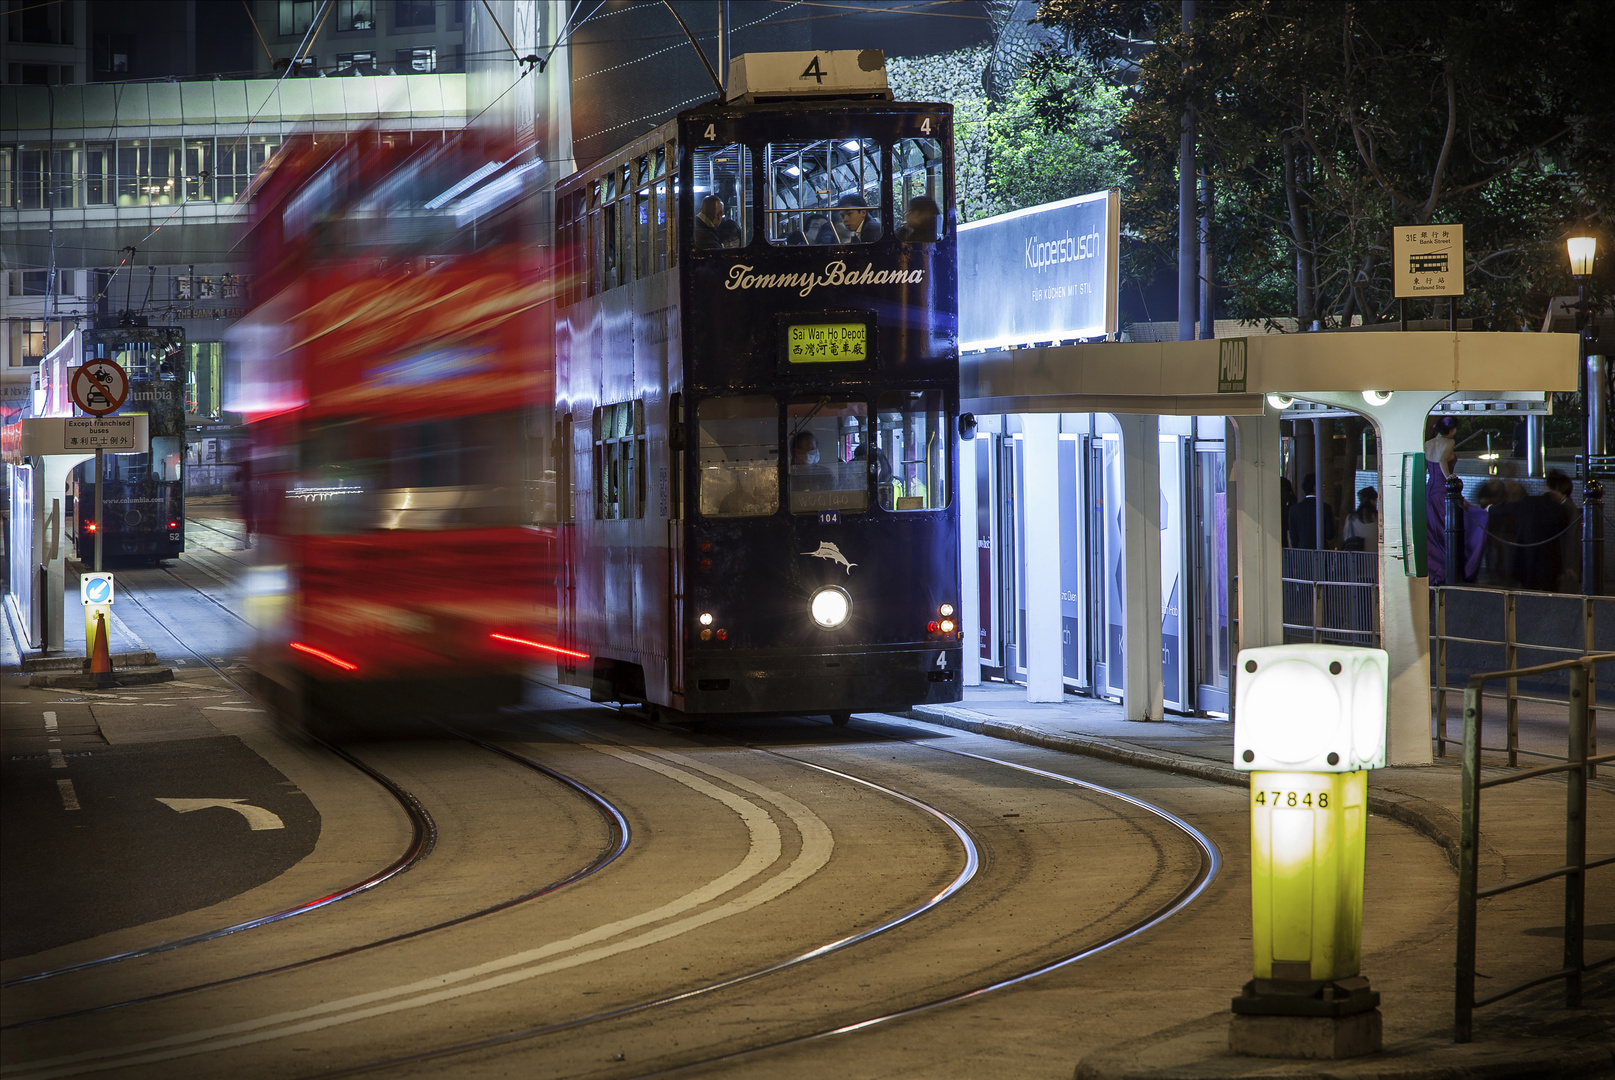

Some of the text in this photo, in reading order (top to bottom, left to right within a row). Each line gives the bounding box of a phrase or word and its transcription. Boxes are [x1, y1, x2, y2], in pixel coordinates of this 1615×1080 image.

[801, 55, 828, 83] 4
[704, 123, 717, 141] 4
[920, 117, 932, 136] 4
[1405, 233, 1417, 242] 31E
[1025, 224, 1100, 274] Küppersbusch
[724, 259, 923, 297] Tommy Bahama
[1414, 277, 1444, 285] 東行站
[1032, 282, 1093, 301] FÜR KÜCHEN MIT STIL
[792, 327, 865, 341] Sai Wan Ho Depot
[792, 342, 865, 357] 西灣河電車廠
[1221, 340, 1246, 382] POAD
[70, 436, 128, 446] 專利巴士例外
[103, 496, 165, 505] www.columbia.com
[820, 513, 838, 523] 104
[169, 533, 180, 541] 52
[936, 650, 947, 670] 4
[1255, 791, 1329, 808] 47848
